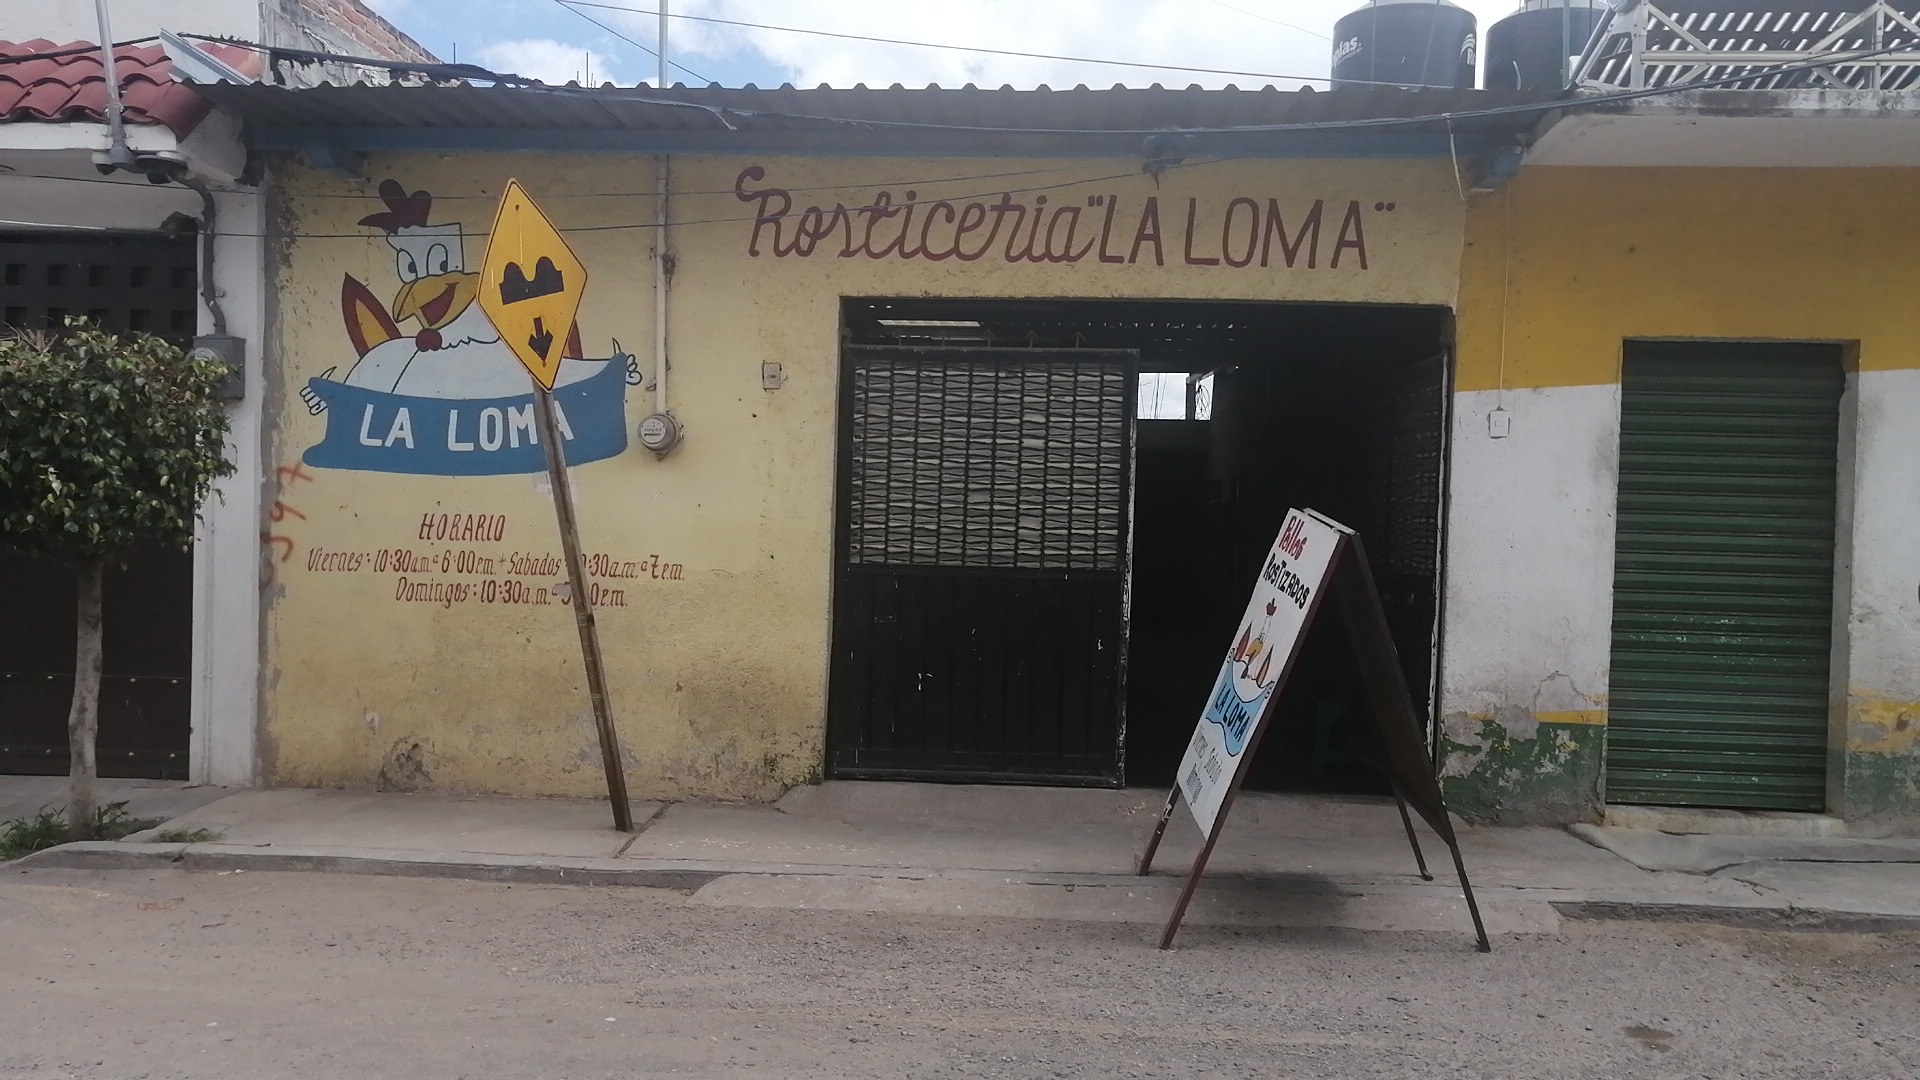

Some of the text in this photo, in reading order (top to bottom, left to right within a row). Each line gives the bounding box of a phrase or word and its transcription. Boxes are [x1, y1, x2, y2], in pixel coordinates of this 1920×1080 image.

[735, 165, 1095, 263] Rosticeria
[359, 403, 414, 449] LA
[418, 513, 505, 542] HORARIO
[1279, 515, 1308, 561] Pollos
[1215, 683, 1250, 743] LA LOMA
